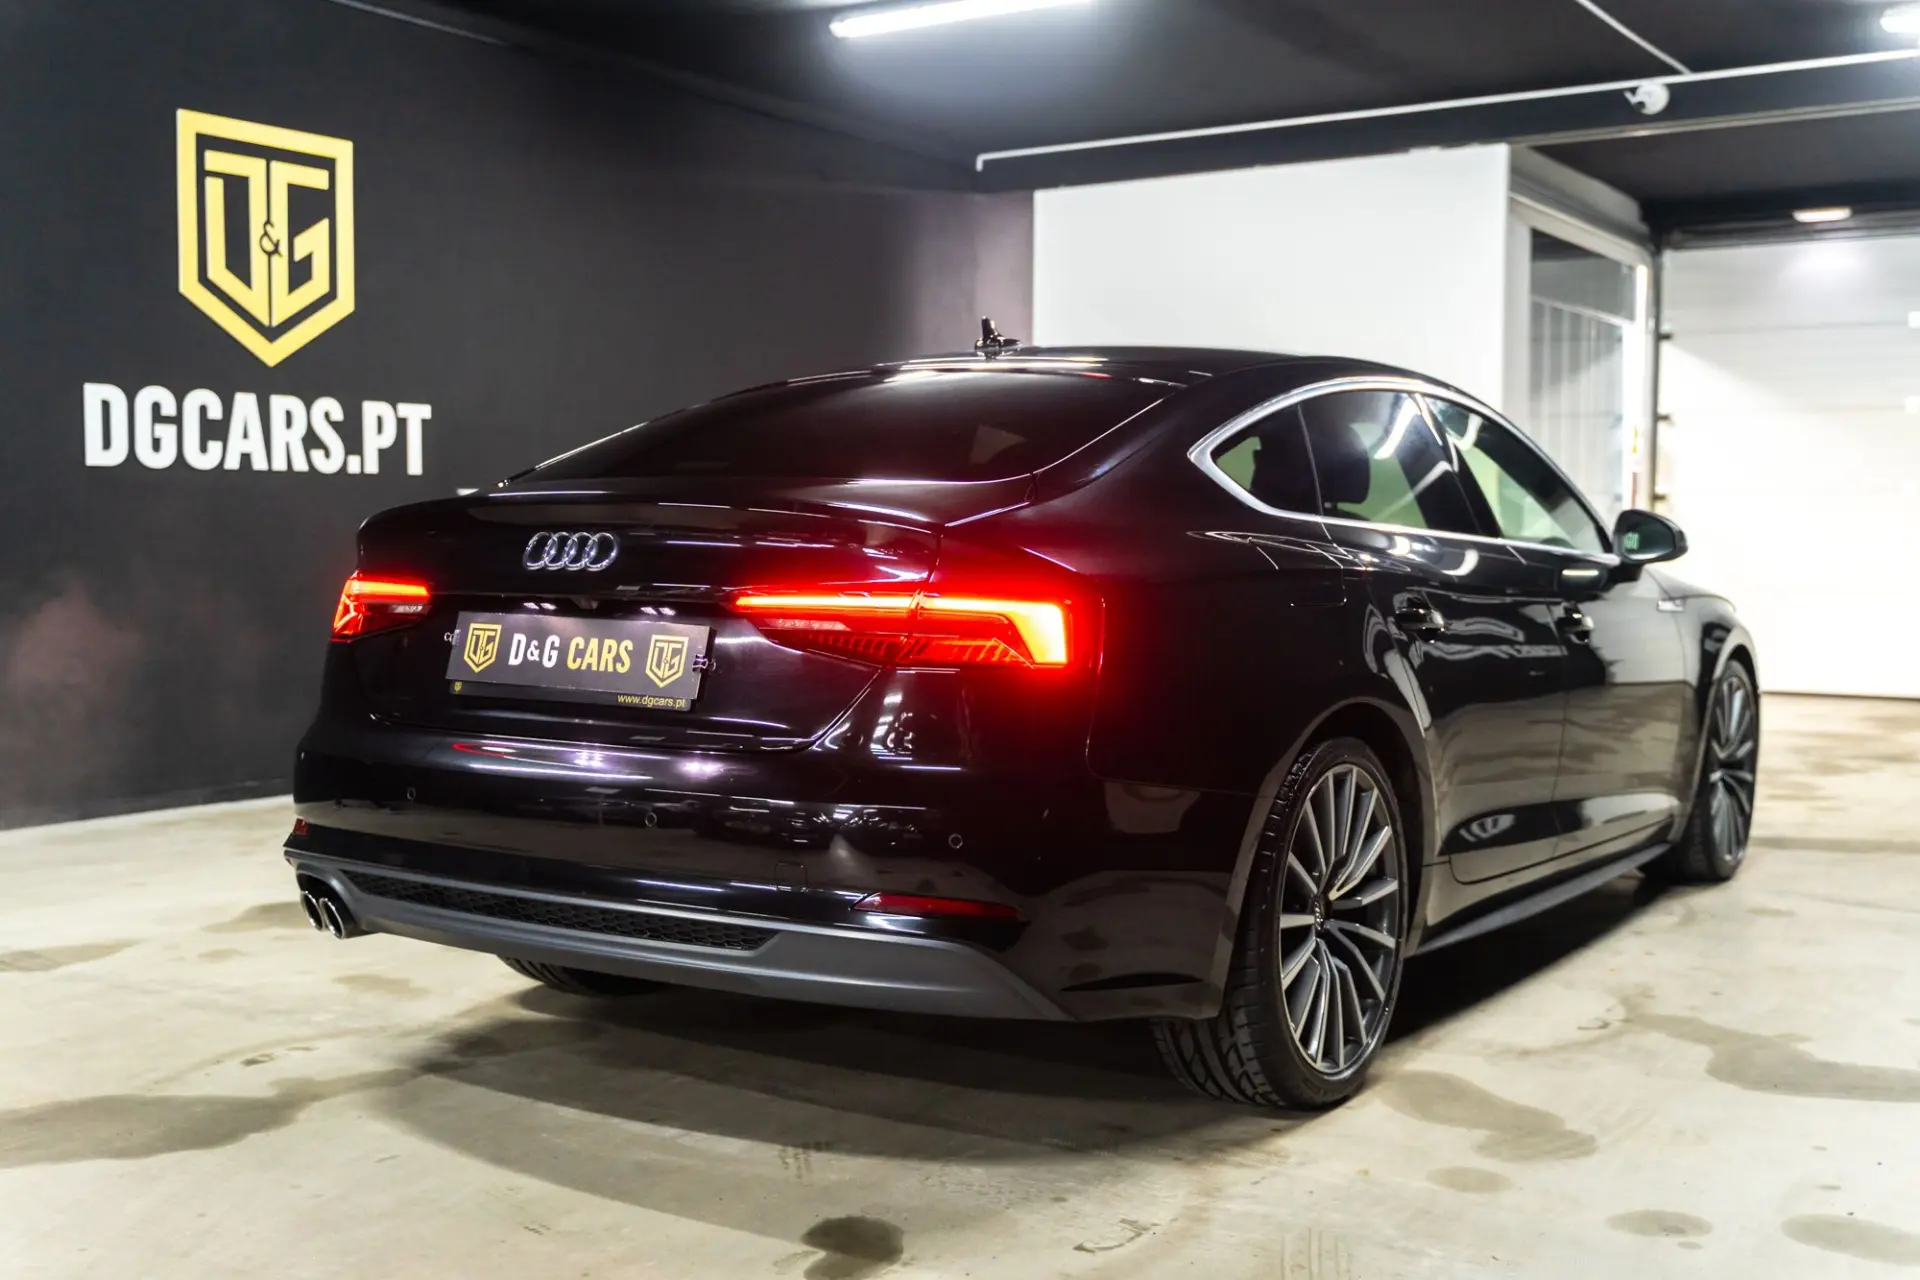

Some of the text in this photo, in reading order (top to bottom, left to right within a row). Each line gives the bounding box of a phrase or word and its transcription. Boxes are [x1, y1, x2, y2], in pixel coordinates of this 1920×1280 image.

[83, 382, 432, 476] DGCARS.PT
[508, 632, 634, 674] D&G CARS
[617, 694, 686, 709] www.dgcars.pt
